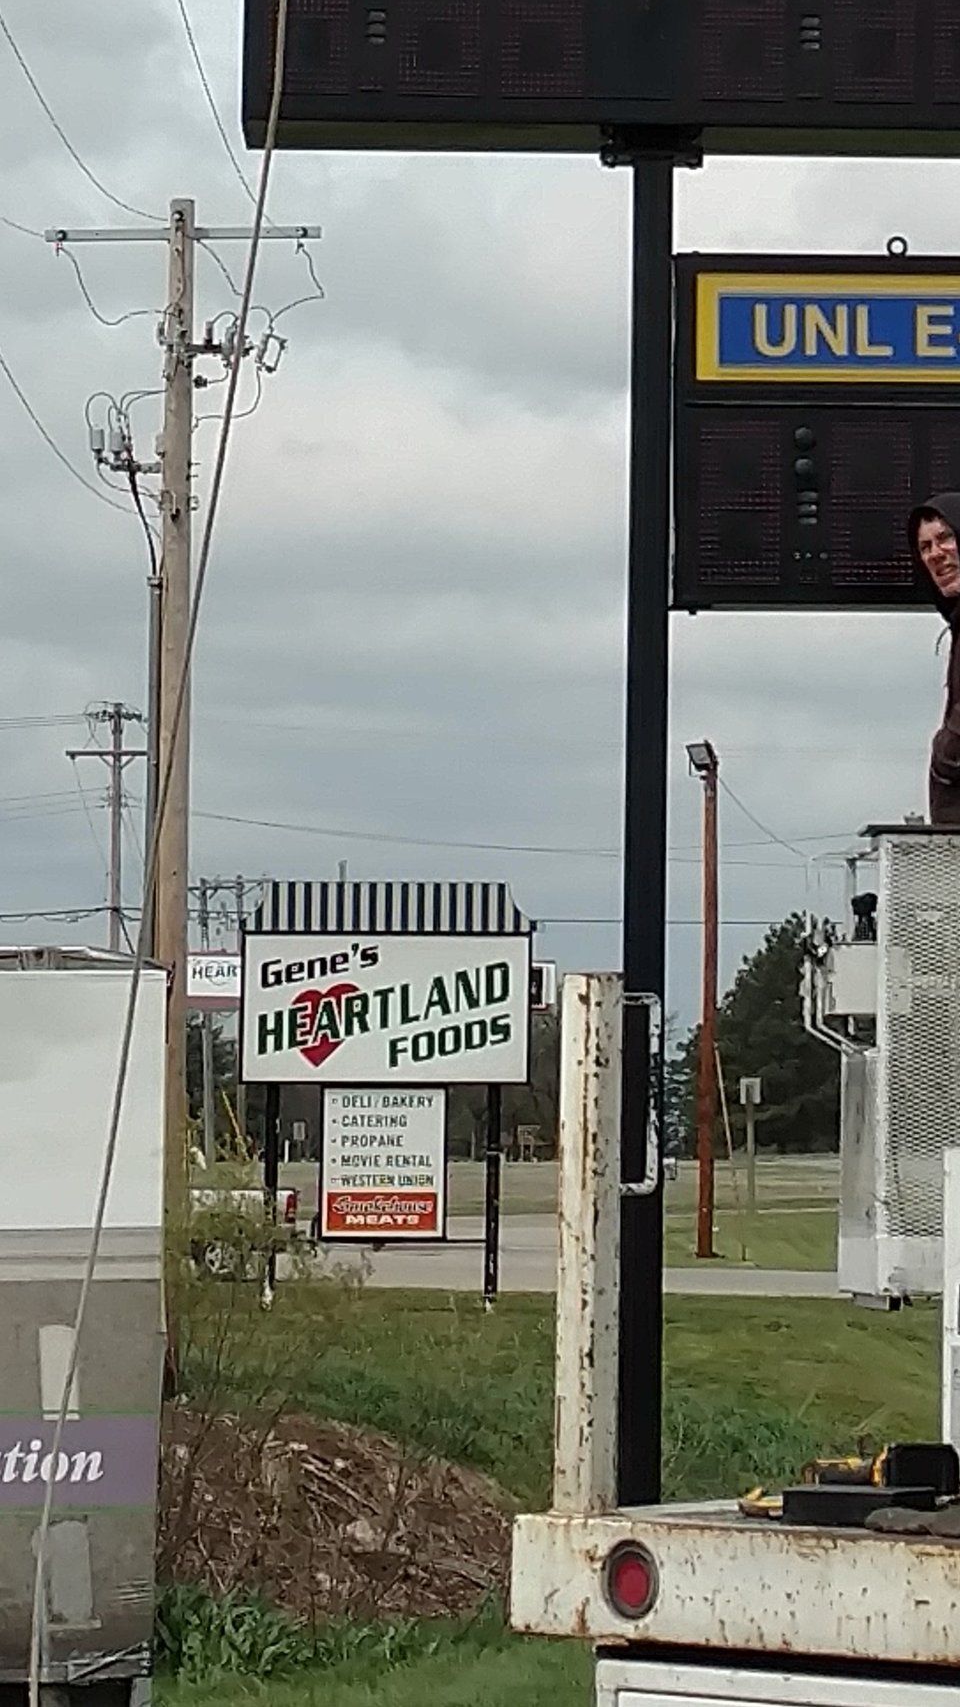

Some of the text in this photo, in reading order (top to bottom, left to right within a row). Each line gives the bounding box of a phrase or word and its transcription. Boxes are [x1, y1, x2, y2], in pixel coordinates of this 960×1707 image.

[752, 303, 894, 359] UNL
[260, 943, 380, 989] Gene's
[257, 961, 511, 1056] HEARTLAND
[388, 1013, 512, 1069] FOODS
[341, 1115, 408, 1128] CATERING
[341, 1135, 405, 1147] PROPANE
[341, 1154, 433, 1168] MOVIE RENTAL
[341, 1174, 434, 1187] WESTERN UNION
[345, 1214, 420, 1225] MEATS
[0, 1438, 104, 1484] tion
